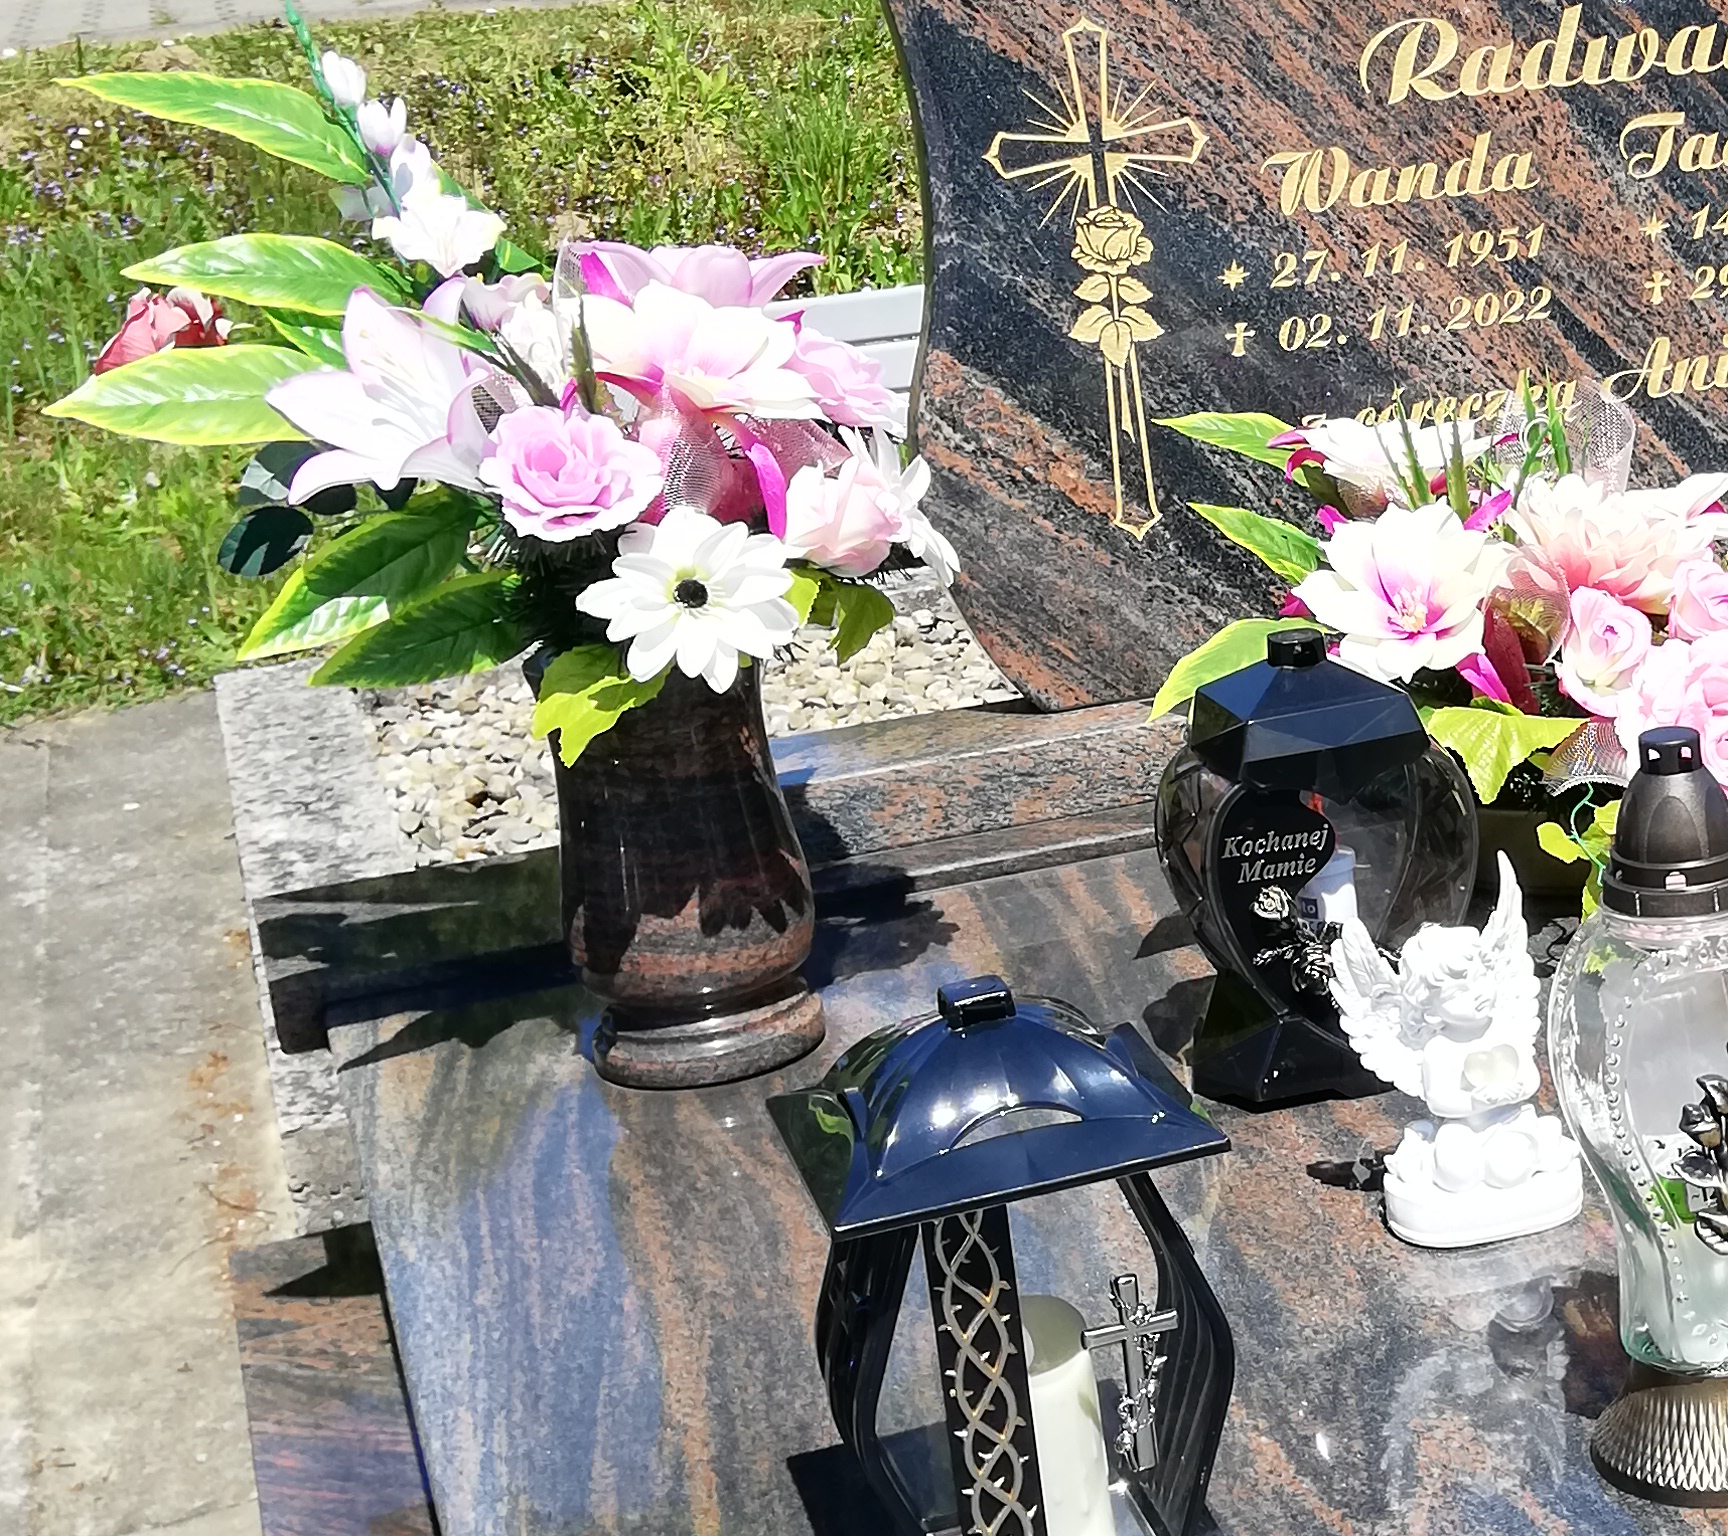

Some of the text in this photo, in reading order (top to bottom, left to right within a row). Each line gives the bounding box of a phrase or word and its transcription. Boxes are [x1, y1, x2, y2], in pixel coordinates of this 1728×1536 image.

[1260, 131, 1540, 215] Wanda
[1270, 223, 1545, 289] 27. 11. 1951
[1278, 286, 1552, 351] 02. 11. 2022
[1221, 823, 1329, 859] Kochanej
[1237, 852, 1317, 884] Mamie
